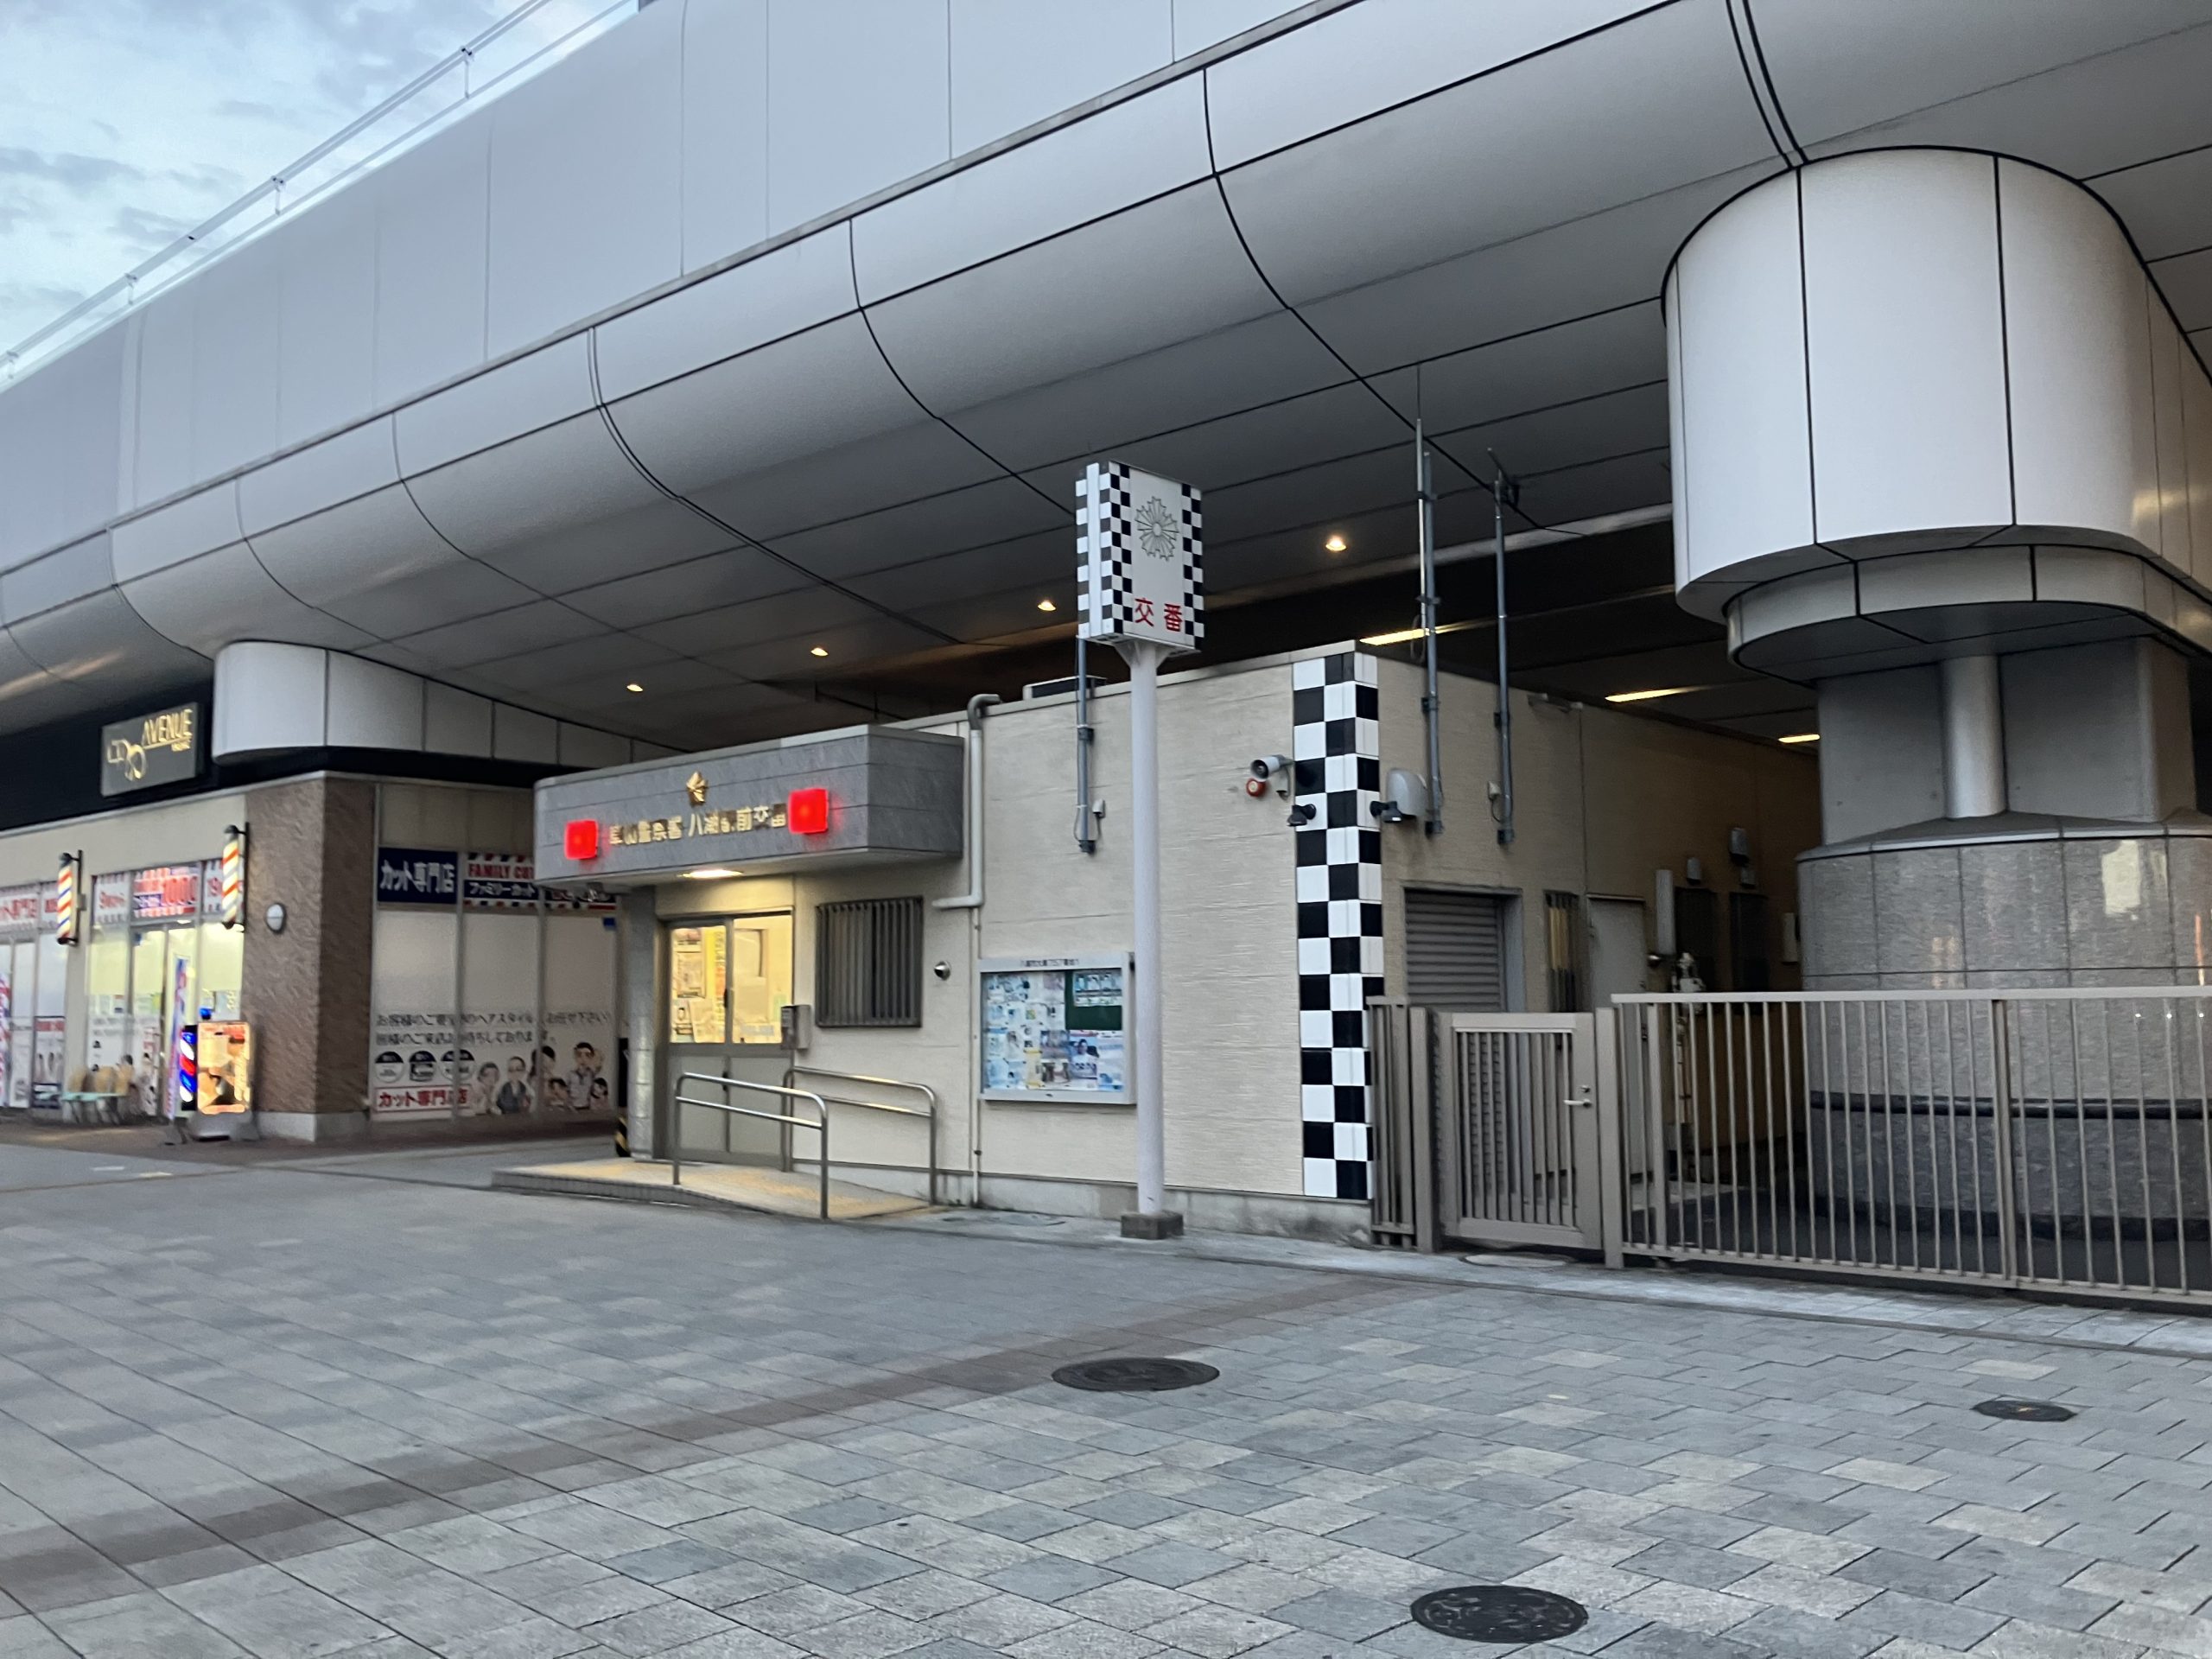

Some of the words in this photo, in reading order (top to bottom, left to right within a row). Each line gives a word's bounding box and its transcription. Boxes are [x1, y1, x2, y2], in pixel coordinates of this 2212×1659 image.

[1135, 597, 1184, 632] 交番
[142, 708, 194, 746] AVENUE
[379, 859, 456, 894] カット専門店
[468, 864, 510, 878] FAMILY
